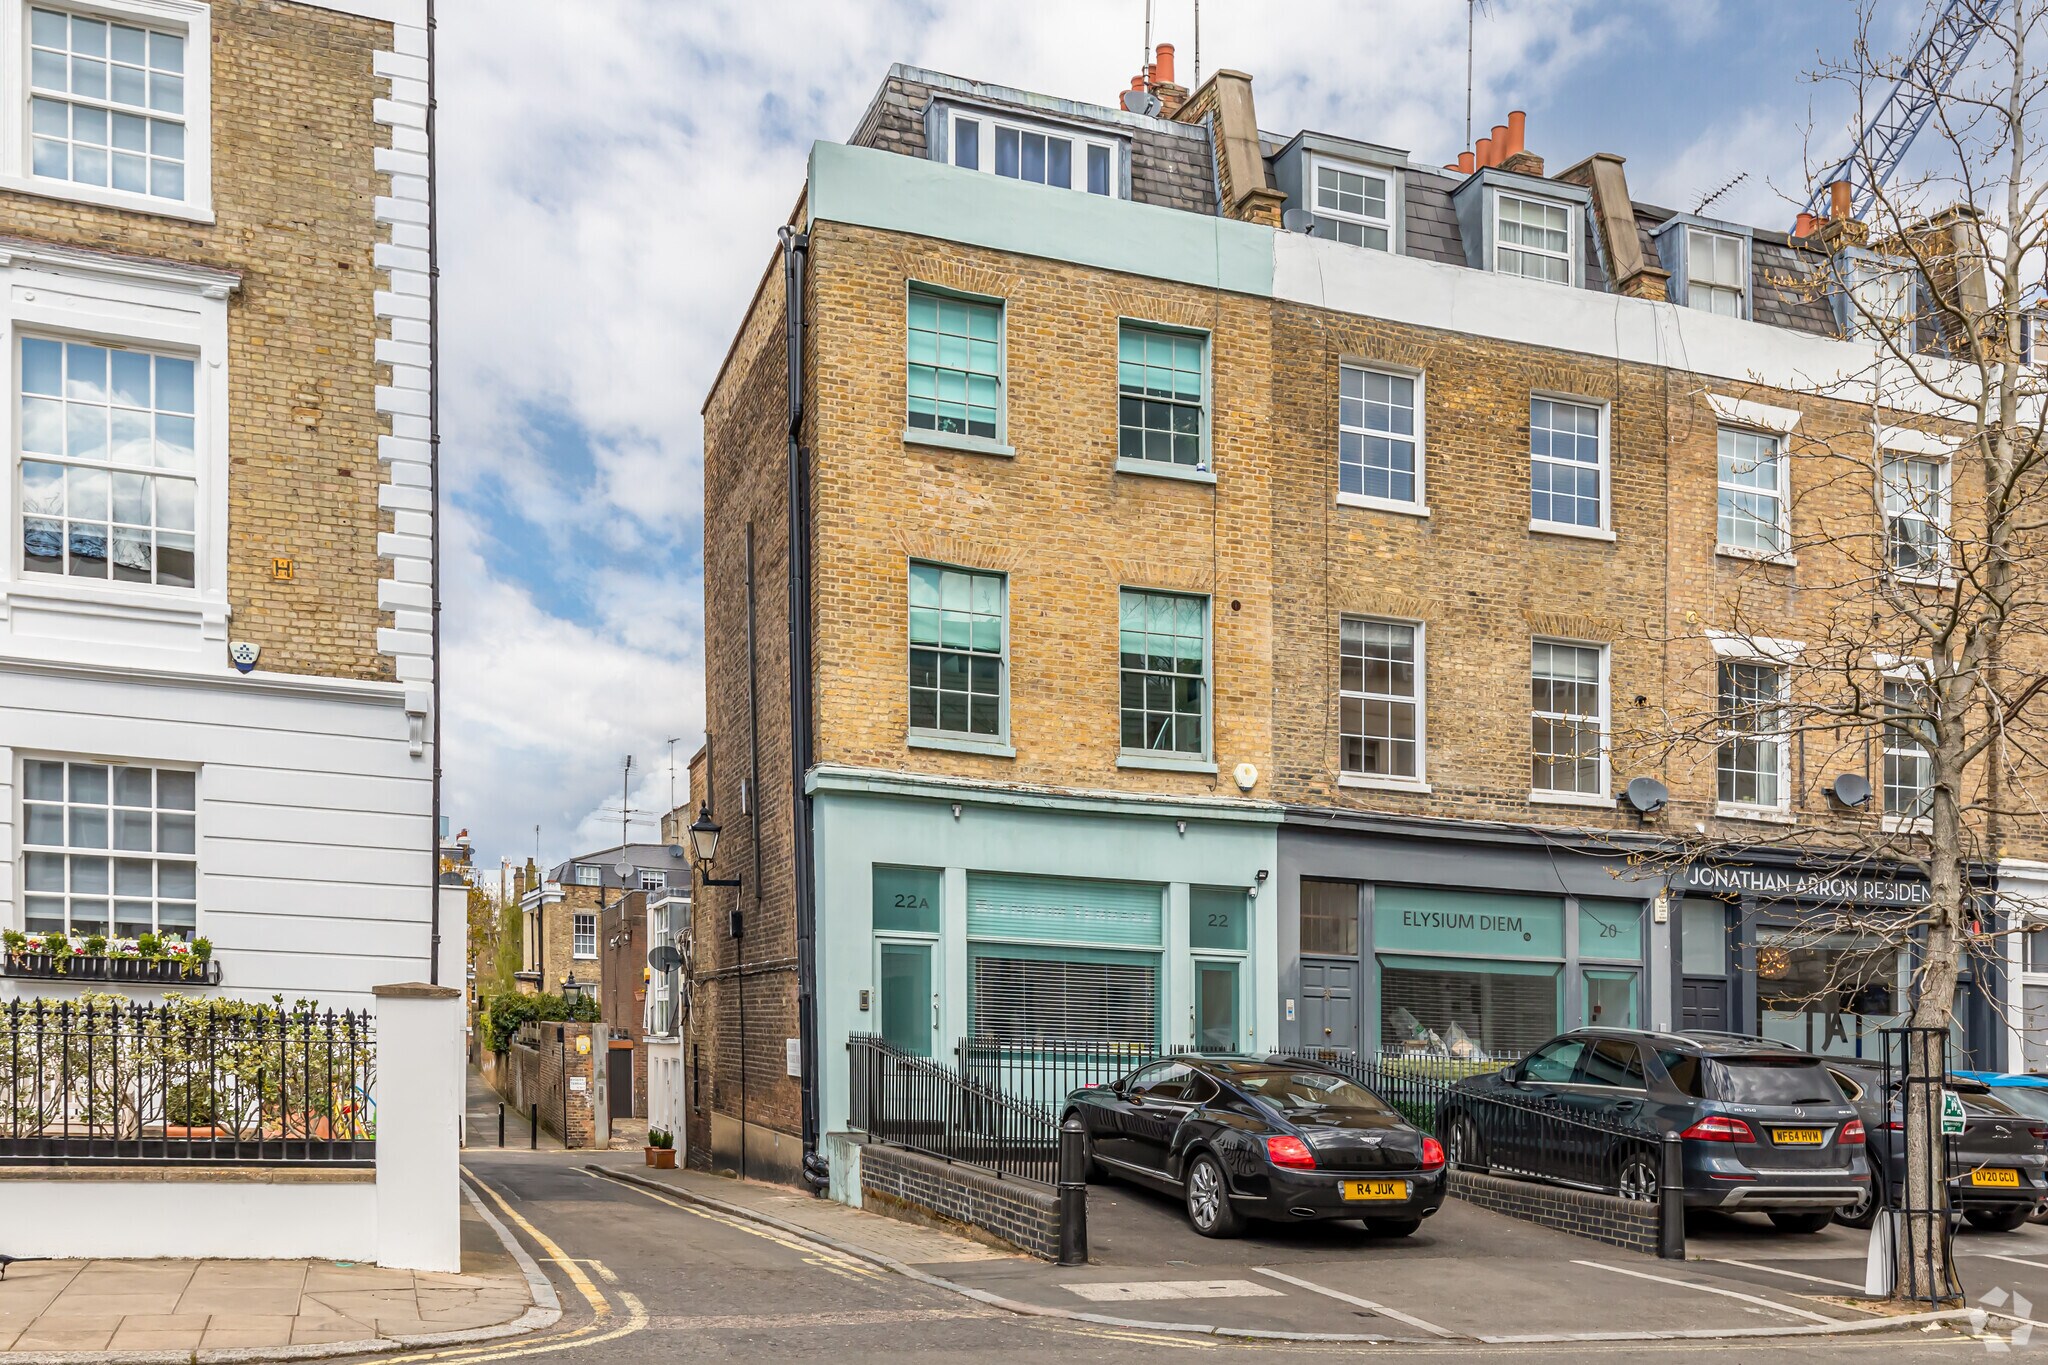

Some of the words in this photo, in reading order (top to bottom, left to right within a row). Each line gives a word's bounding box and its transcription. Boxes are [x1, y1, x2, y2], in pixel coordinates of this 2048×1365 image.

[275, 559, 290, 577] H
[1689, 867, 1790, 892] JONATHAN
[1796, 876, 1858, 898] ARRON
[1864, 881, 1967, 905] RESIDEN
[894, 893, 930, 910] 22A
[1208, 913, 1229, 928] 22
[1403, 910, 1474, 930] ELYSIUM
[1480, 915, 1523, 933] DIEM
[1600, 924, 1617, 938] 20
[1776, 1130, 1799, 1141] WF64
[1801, 1131, 1819, 1141] HVM
[1975, 1171, 1997, 1182] OV20
[1999, 1172, 2015, 1182] GCU
[1357, 1183, 1371, 1195] R4
[1375, 1183, 1395, 1195] JUK
